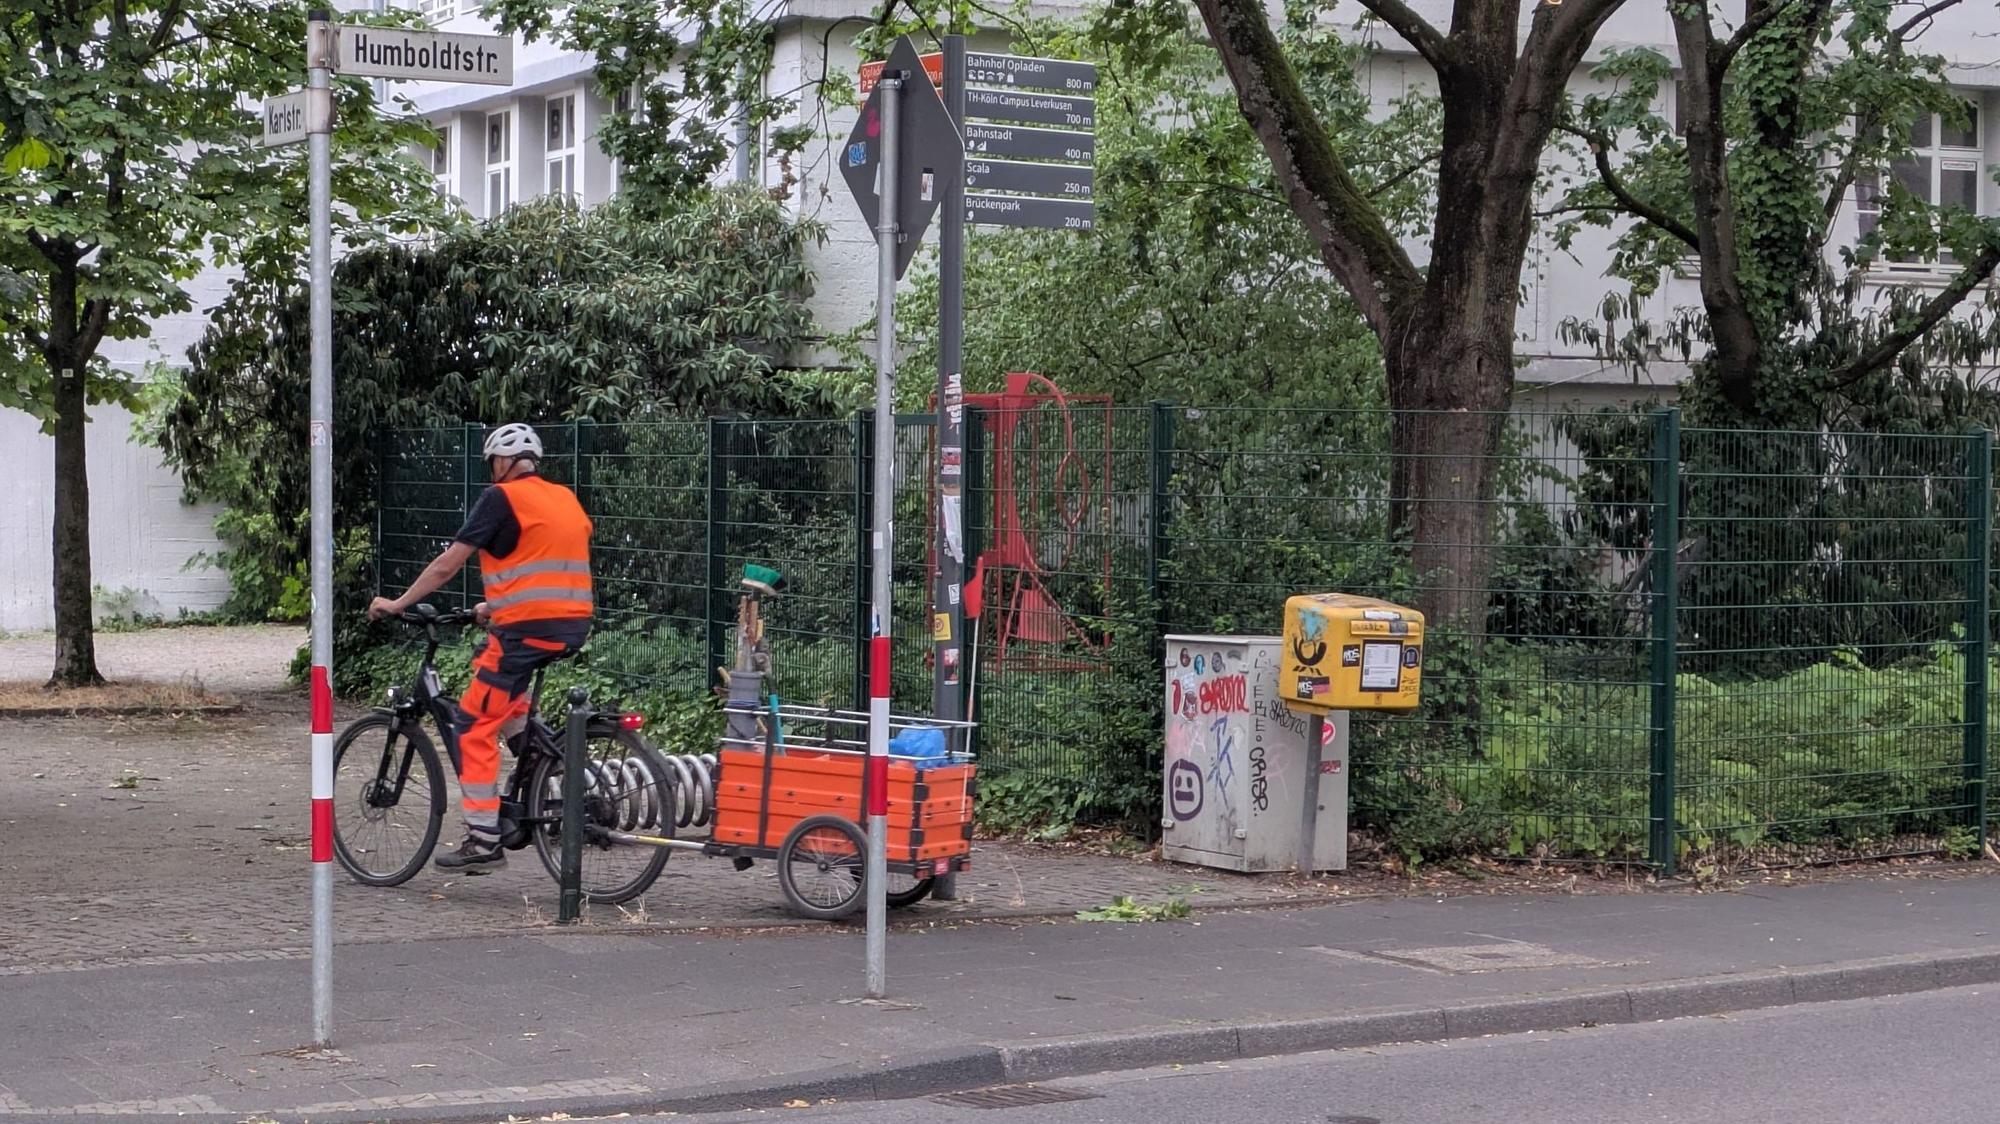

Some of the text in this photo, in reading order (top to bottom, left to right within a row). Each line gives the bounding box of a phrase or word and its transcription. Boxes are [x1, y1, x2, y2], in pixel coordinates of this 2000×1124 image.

[355, 33, 498, 74] Humboldtstr.
[967, 56, 1045, 73] Bahnhof Opladen
[863, 66, 881, 79] Oplad
[1066, 78, 1092, 90] 800 m
[999, 95, 1029, 109] Campus
[1031, 98, 1072, 111] Leverkusen
[269, 104, 301, 135] Karlstr.
[1066, 113, 1091, 126] 700 m
[966, 127, 1012, 141] Bahnstadt
[1065, 148, 1091, 160] 400 m
[966, 162, 990, 174] Scala
[1065, 183, 1090, 194] 250 m
[966, 198, 1021, 212] Brückenpark
[1065, 217, 1091, 228] 200 m
